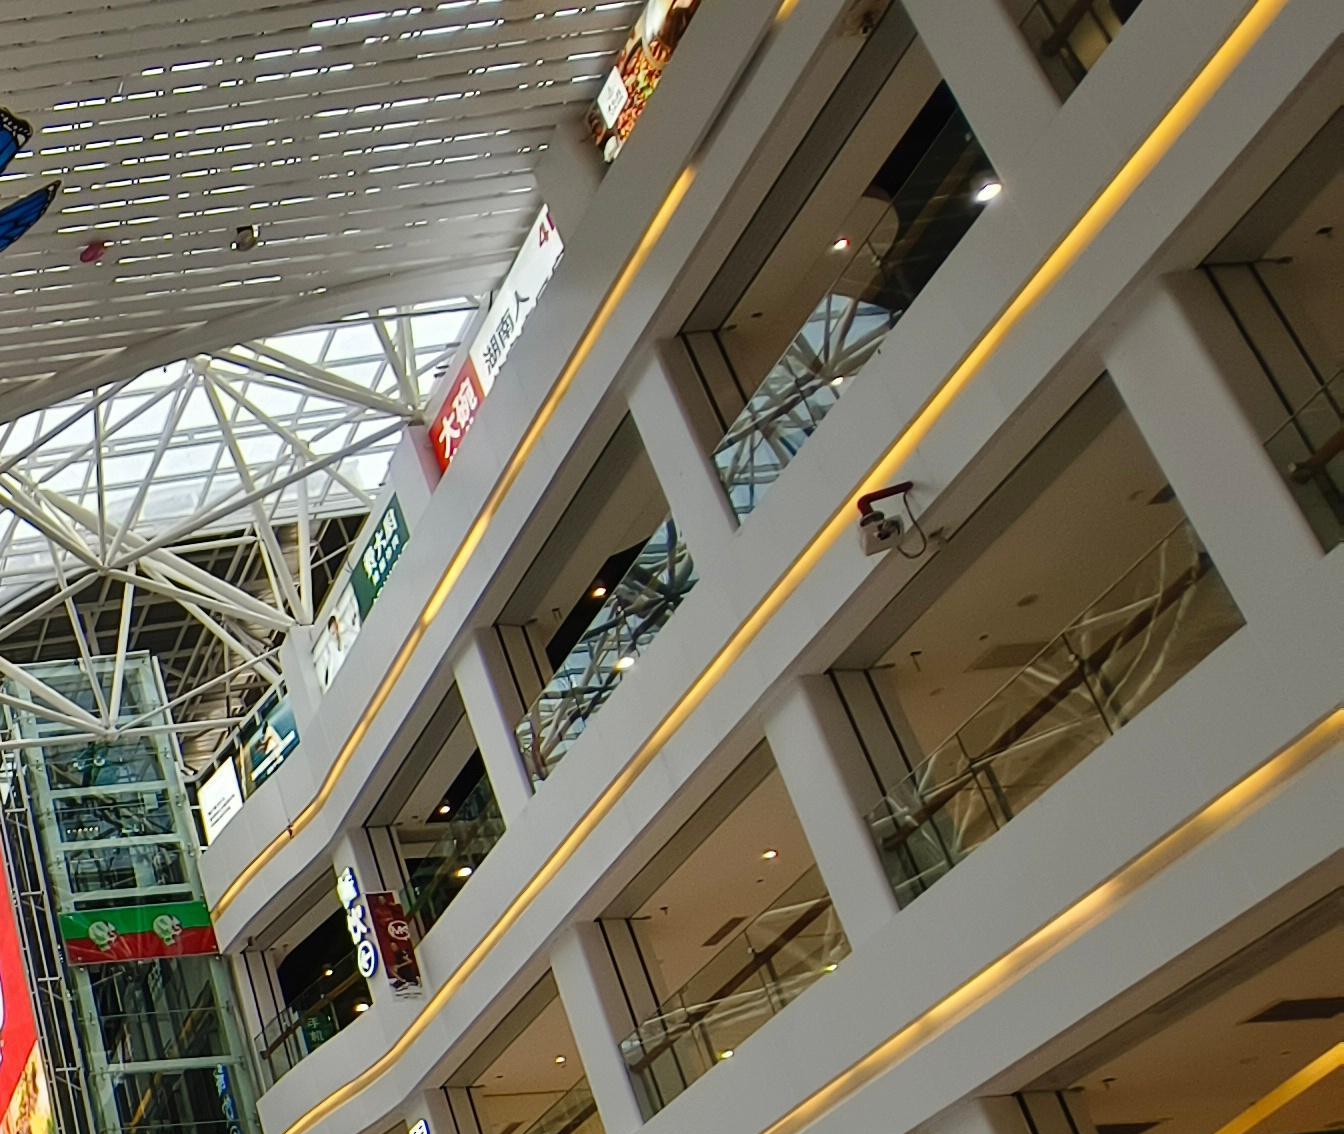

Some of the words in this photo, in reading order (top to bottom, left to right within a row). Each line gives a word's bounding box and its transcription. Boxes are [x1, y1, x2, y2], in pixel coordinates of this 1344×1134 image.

[483, 290, 530, 373] 湖南人
[439, 377, 478, 459] 大碗
